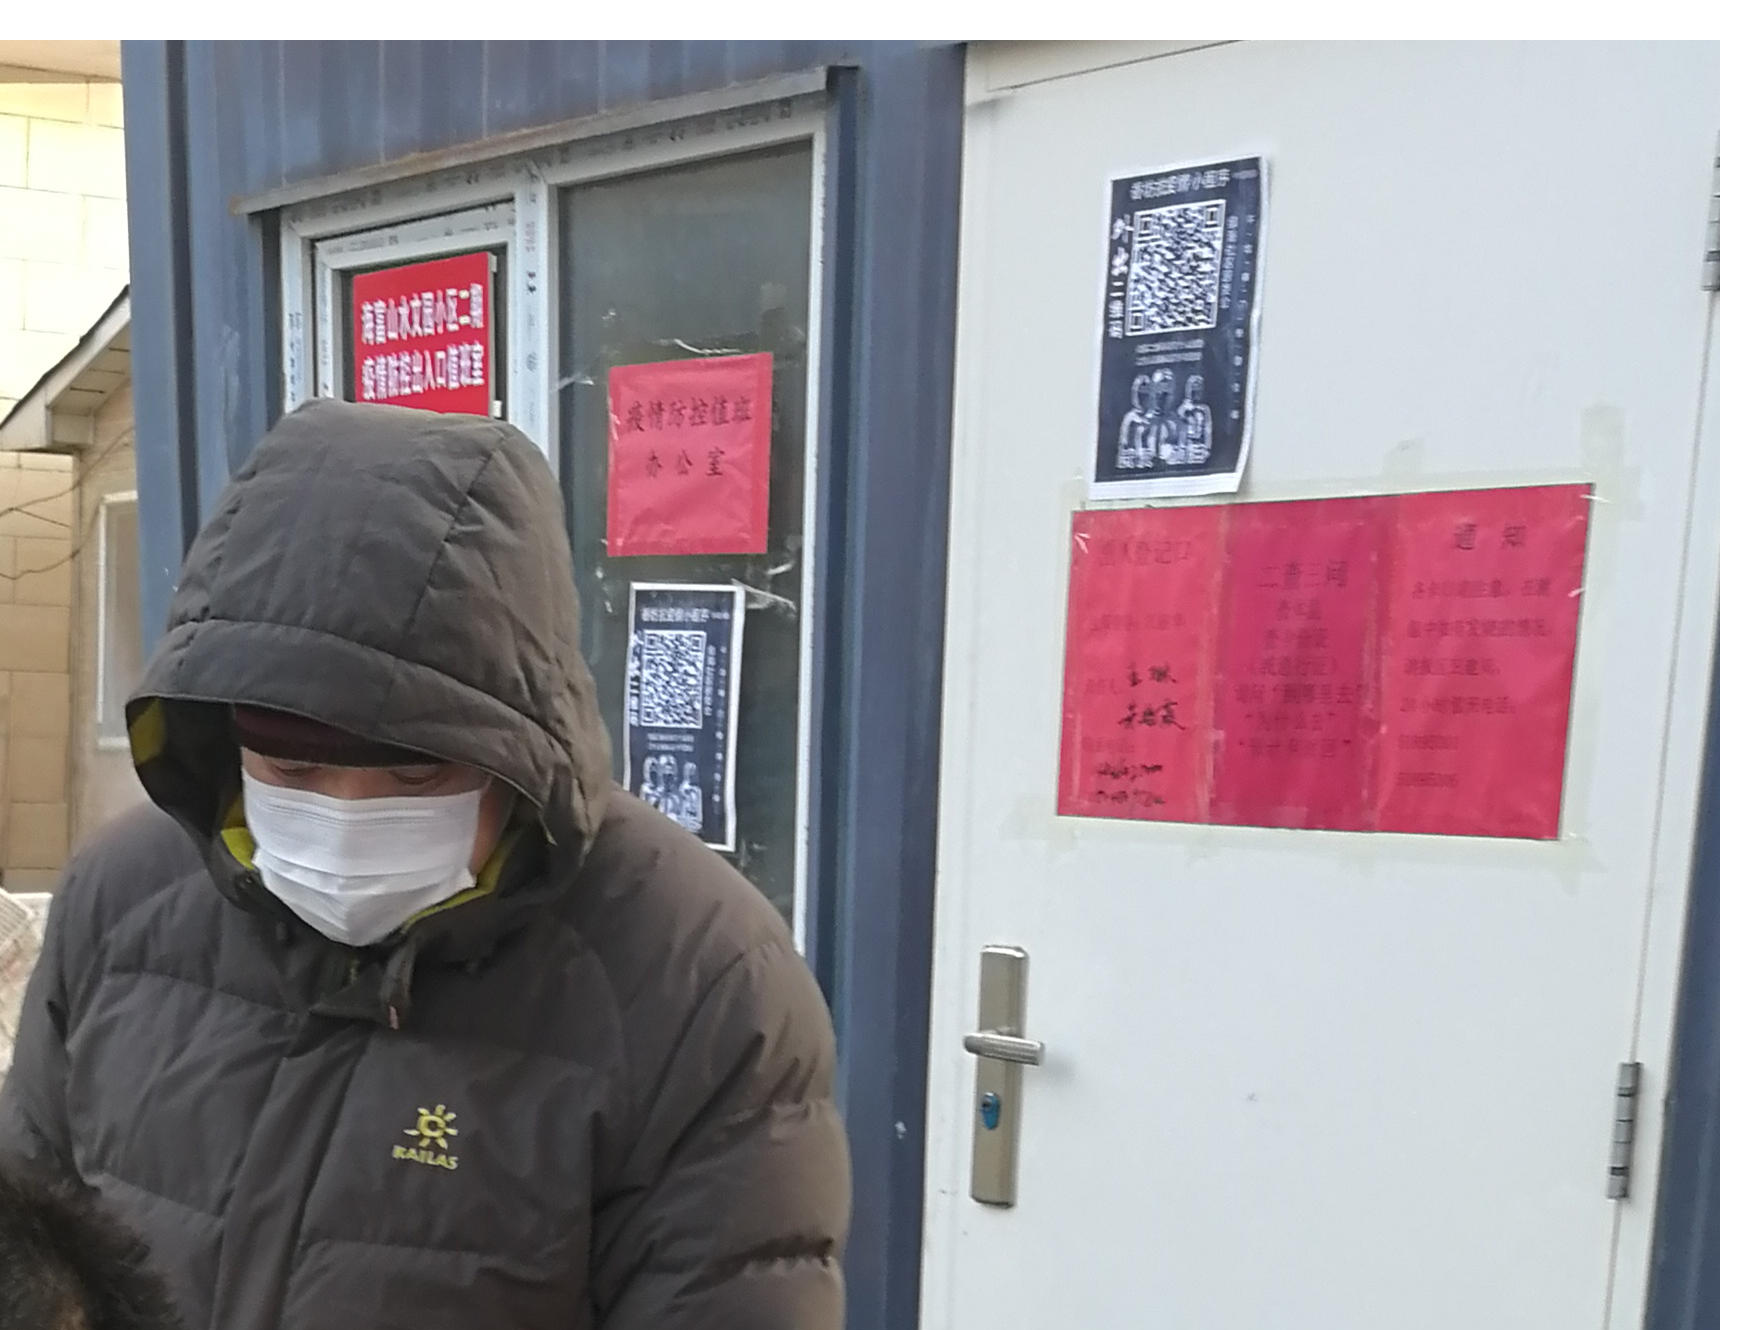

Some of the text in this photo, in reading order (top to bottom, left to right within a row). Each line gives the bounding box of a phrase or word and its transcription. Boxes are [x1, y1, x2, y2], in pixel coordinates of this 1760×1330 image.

[361, 283, 484, 346] 海富山水文园小区二期
[361, 340, 485, 400] 疫情防控出入口值班室
[627, 397, 753, 433] 疫情防控值班
[646, 447, 725, 478] 办公室
[392, 1145, 458, 1170] KAILAS
